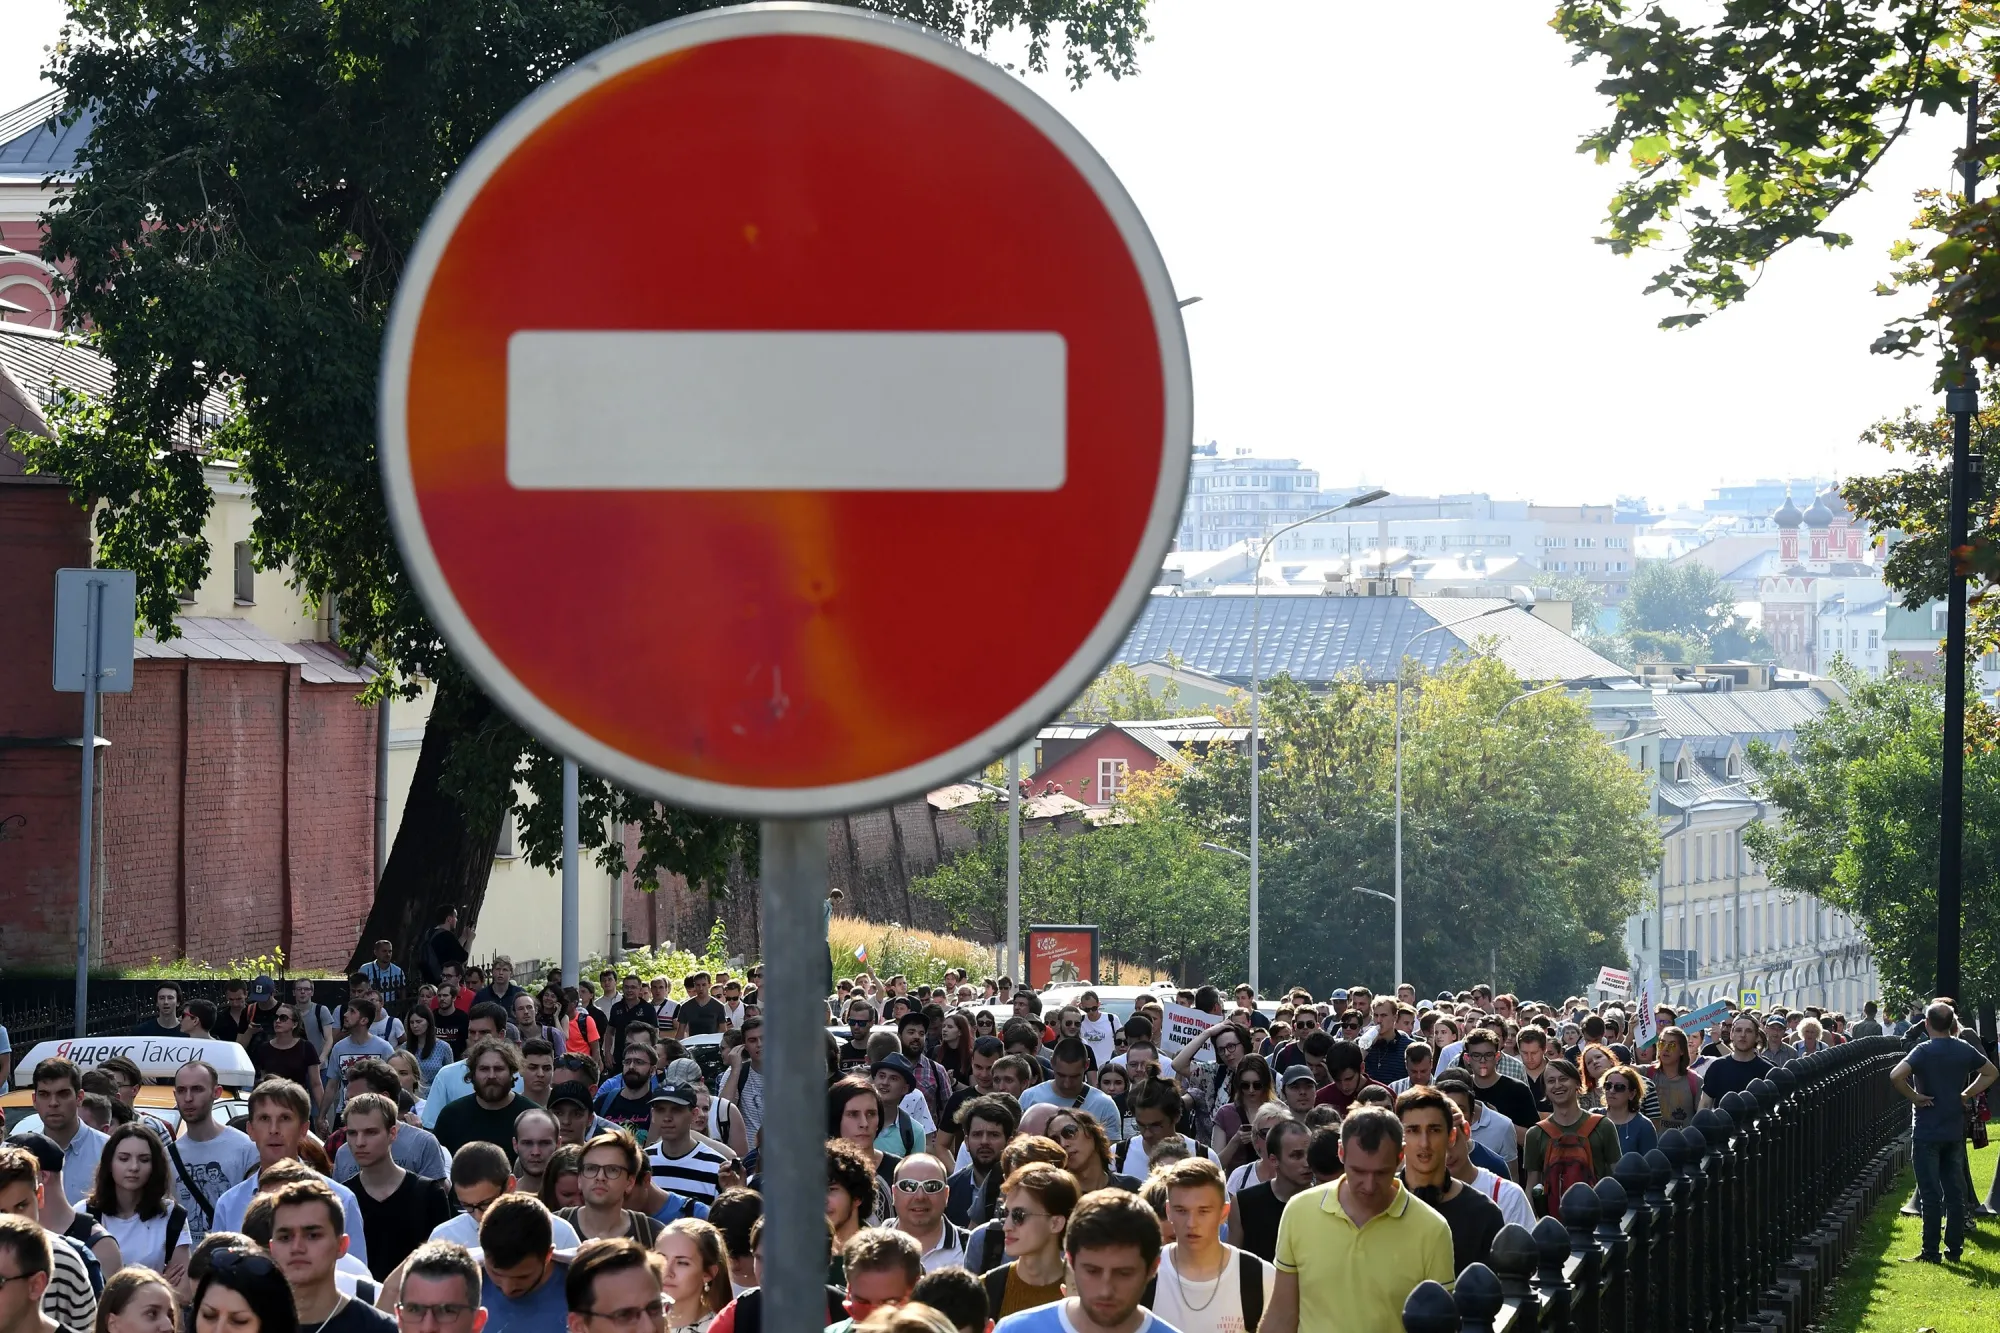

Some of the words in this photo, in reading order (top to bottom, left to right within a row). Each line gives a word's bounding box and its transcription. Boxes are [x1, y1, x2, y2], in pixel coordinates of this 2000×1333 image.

[1168, 1012, 1173, 1020] Я
[1173, 1014, 1194, 1026] ИМЕЮ
[1680, 1018, 1698, 1030] ИВАН
[435, 1027, 458, 1035] RUMP
[1173, 1024, 1181, 1033] НА
[56, 1041, 134, 1065] Яндекс
[141, 1040, 204, 1063] Такси
